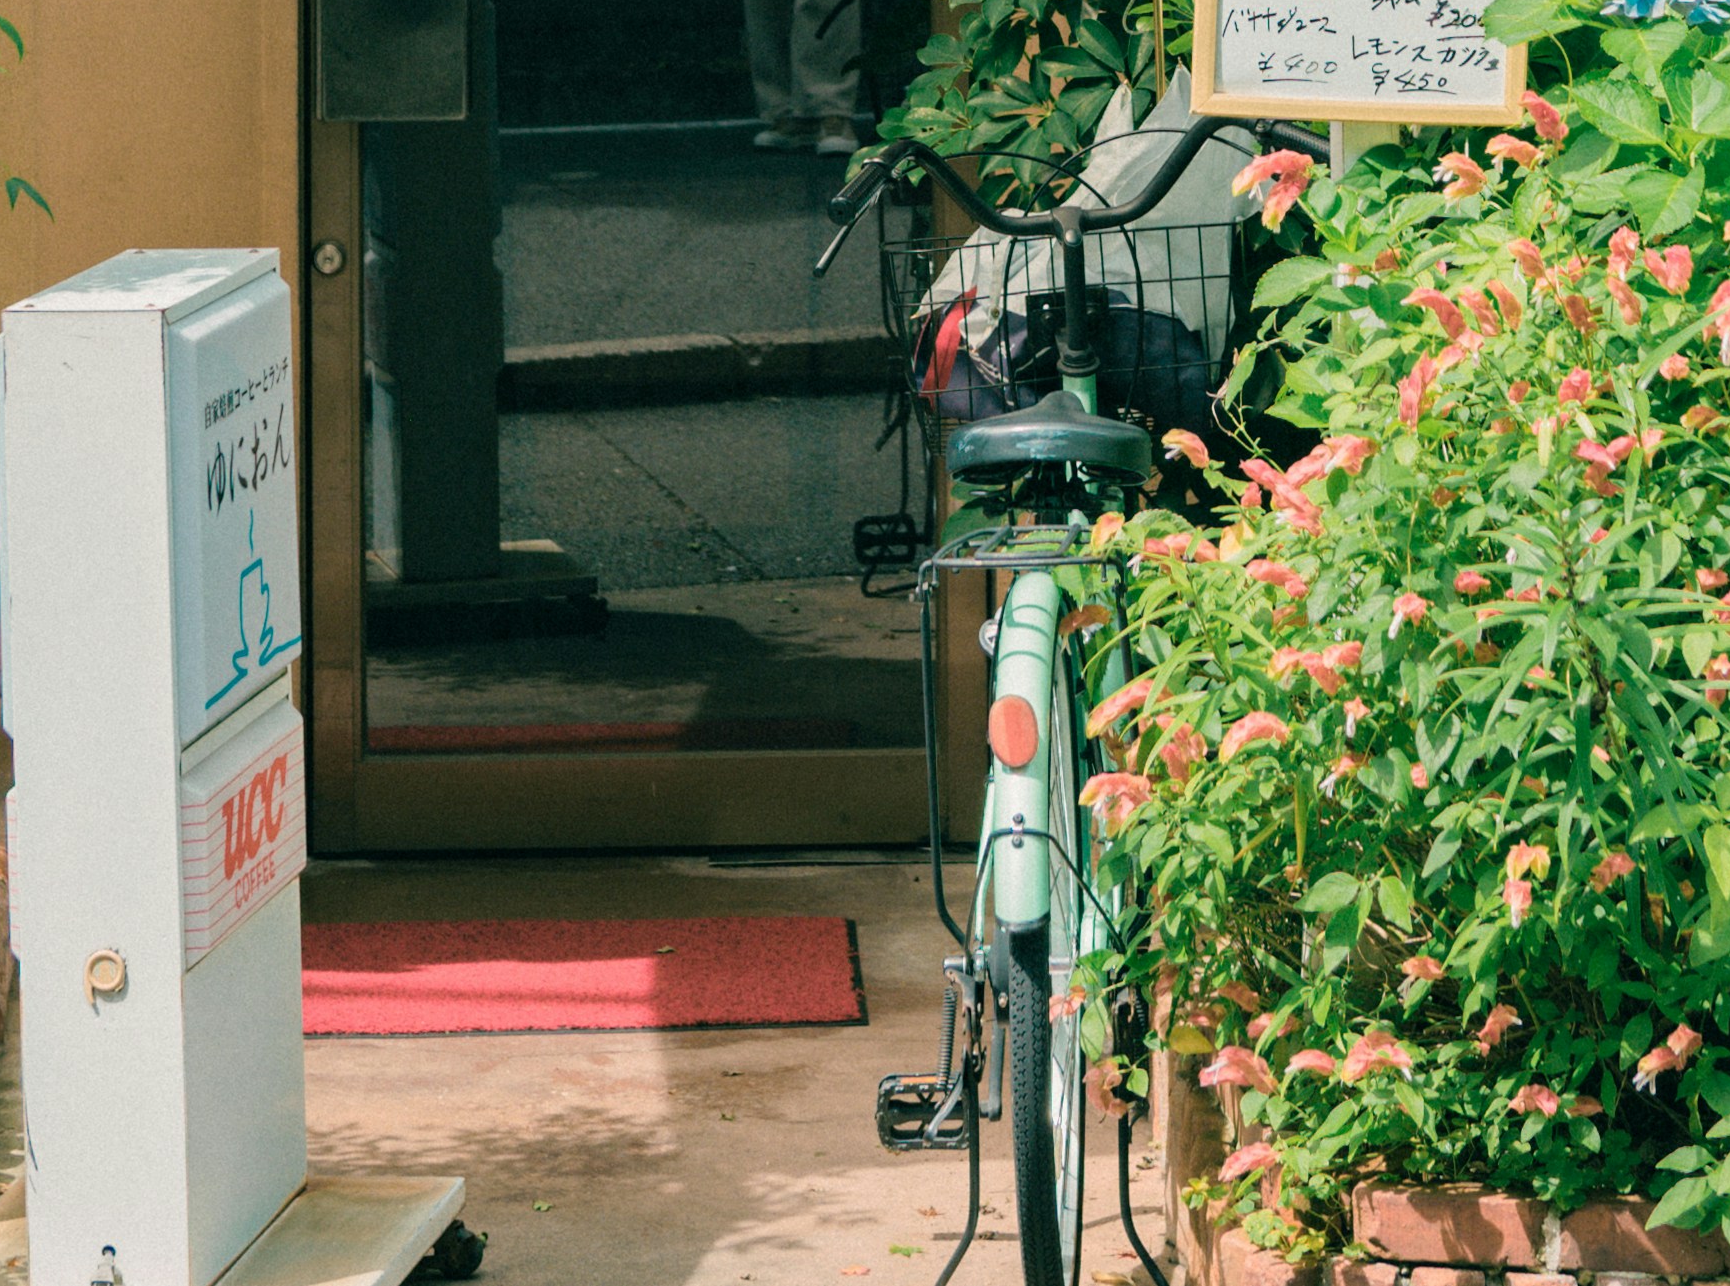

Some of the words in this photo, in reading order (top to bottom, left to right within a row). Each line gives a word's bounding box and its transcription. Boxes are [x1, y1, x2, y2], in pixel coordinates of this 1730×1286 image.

[207, 402, 292, 517] ゆにおん
[222, 752, 288, 881] UCC
[235, 850, 275, 909] COFFEE
